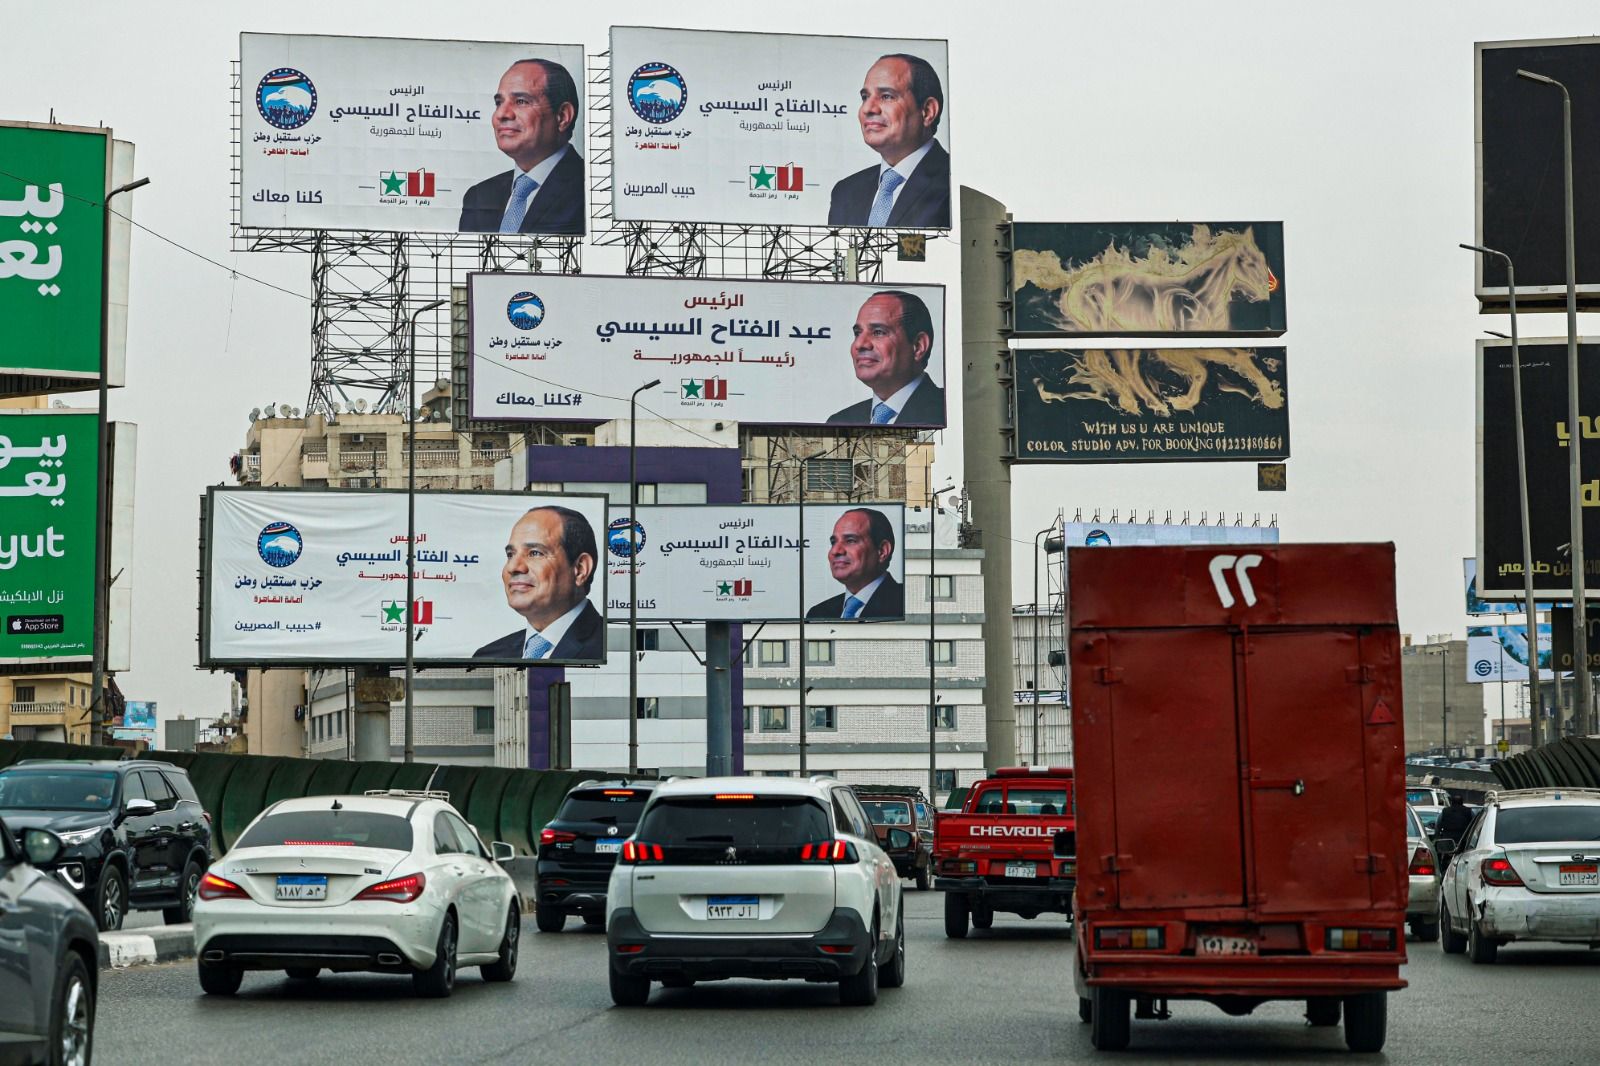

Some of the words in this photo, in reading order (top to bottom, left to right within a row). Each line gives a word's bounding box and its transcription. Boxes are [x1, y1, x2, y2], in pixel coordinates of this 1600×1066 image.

[389, 85, 424, 96] الرئيس
[758, 80, 792, 91] الرئيس
[329, 103, 399, 122] السيسي
[406, 103, 481, 123] عبدالفتاح
[699, 97, 768, 117] السيسي
[775, 99, 847, 118] عبدالفتاح
[369, 125, 415, 137] للجمهورية
[625, 126, 642, 136] وطن
[644, 126, 672, 138] مستقبل
[739, 120, 783, 131] للجمهورية
[253, 132, 270, 142] وطن
[273, 132, 301, 143] مستقبل
[304, 133, 322, 144] حزب
[675, 128, 692, 138] حزب
[252, 189, 290, 202] معاك
[623, 182, 668, 197] المصريين
[671, 186, 695, 198] حبيب
[296, 190, 323, 203] كلنا
[684, 291, 744, 310] الرئيس
[596, 317, 702, 343] السيسي
[711, 319, 780, 344] الفتاح
[788, 324, 831, 344] عبد
[489, 336, 508, 348] وطن
[511, 337, 540, 348] مستقبل
[544, 338, 562, 349] حزب
[496, 392, 582, 407] #كلنا_معاك
[1081, 421, 1117, 435] WITH
[1121, 423, 1136, 434] US
[1140, 423, 1148, 434] U
[1153, 422, 1175, 434] ARE
[1180, 421, 1225, 436] UNIQUE
[1027, 440, 1068, 452] COLOR
[1071, 439, 1112, 451] STUDIO
[1115, 440, 1139, 452] ADV.
[1142, 438, 1165, 452] FOR
[1165, 436, 1214, 452] BOOKING
[719, 518, 754, 529] الرئيس
[659, 535, 729, 556] السيسي
[336, 549, 401, 566] السيسي
[453, 553, 479, 567] عبد
[699, 557, 744, 568] للجمهورية
[234, 575, 257, 589] وطن
[260, 575, 297, 589] مستقبل
[300, 577, 322, 590] حزب
[47, 589, 64, 604] نزل
[637, 599, 656, 609] كلنا
[24, 623, 40, 631] App
[40, 622, 59, 630] Store
